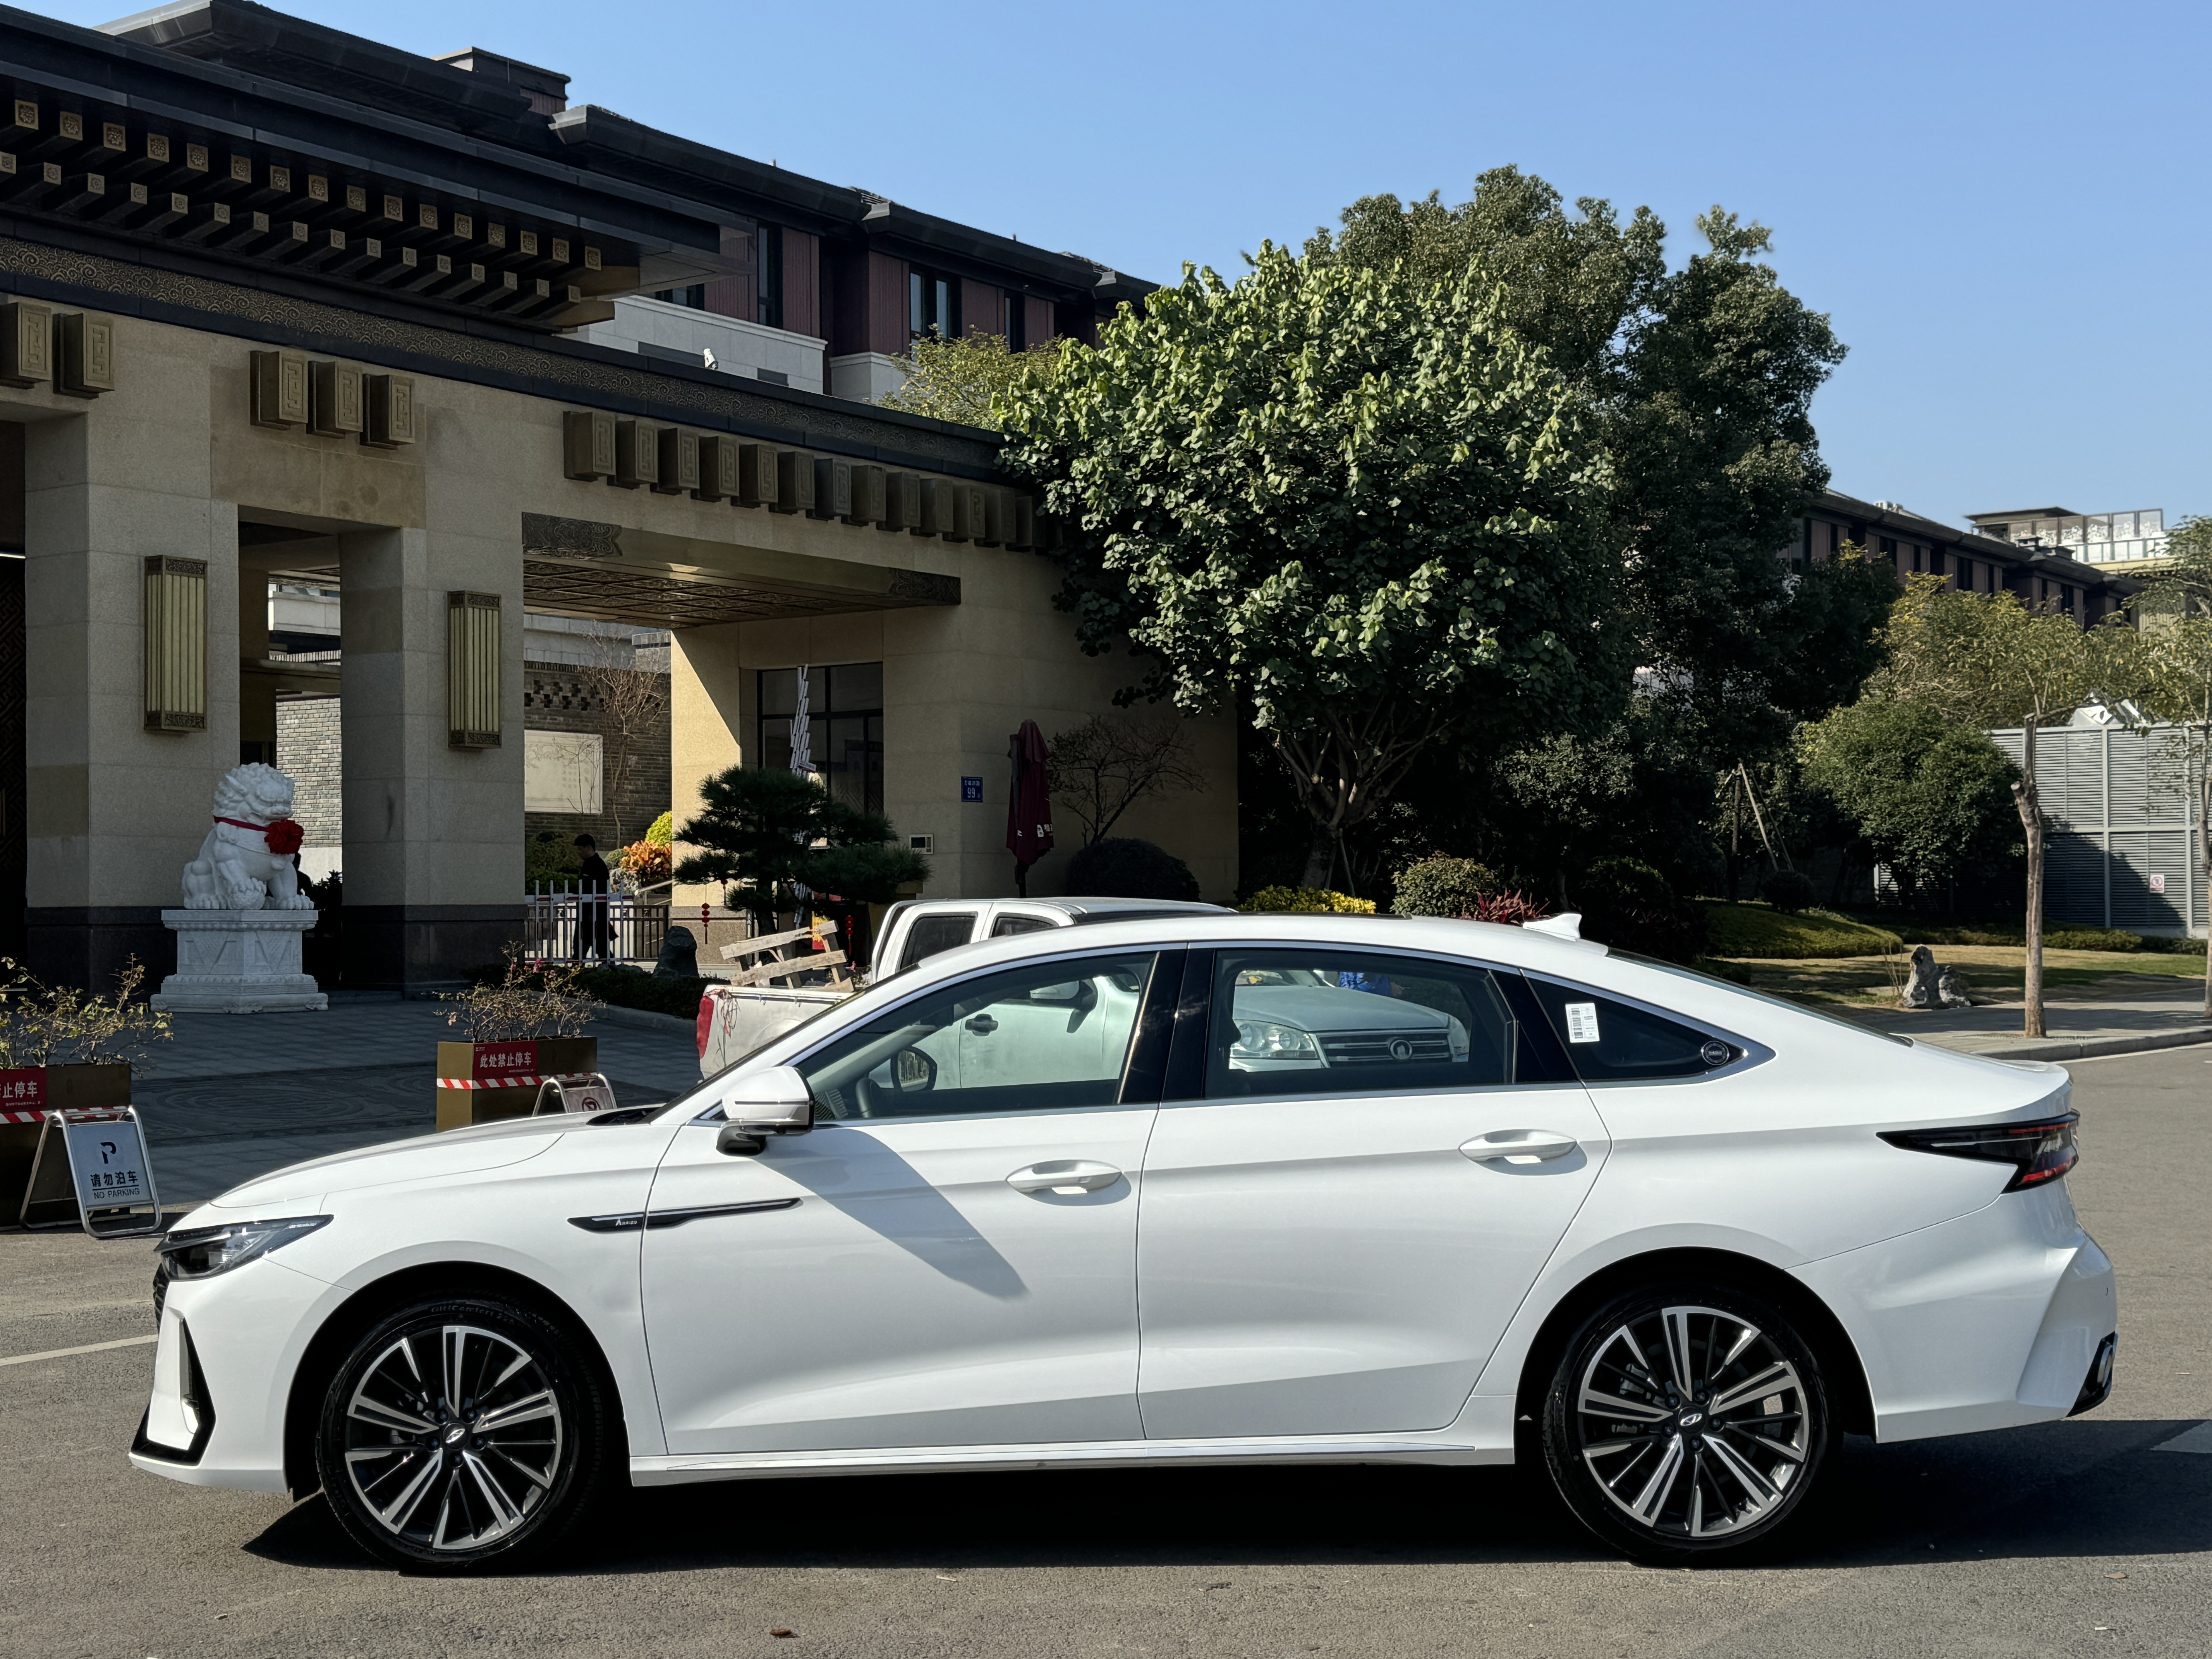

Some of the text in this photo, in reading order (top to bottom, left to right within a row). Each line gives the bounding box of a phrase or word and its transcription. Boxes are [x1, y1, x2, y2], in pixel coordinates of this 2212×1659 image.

[967, 787, 975, 798] 99
[480, 1052, 531, 1068] 此处禁止停车
[0, 1080, 38, 1098] 止停车
[90, 1170, 138, 1187] 请勿泊车
[108, 1188, 140, 1197] PARKING
